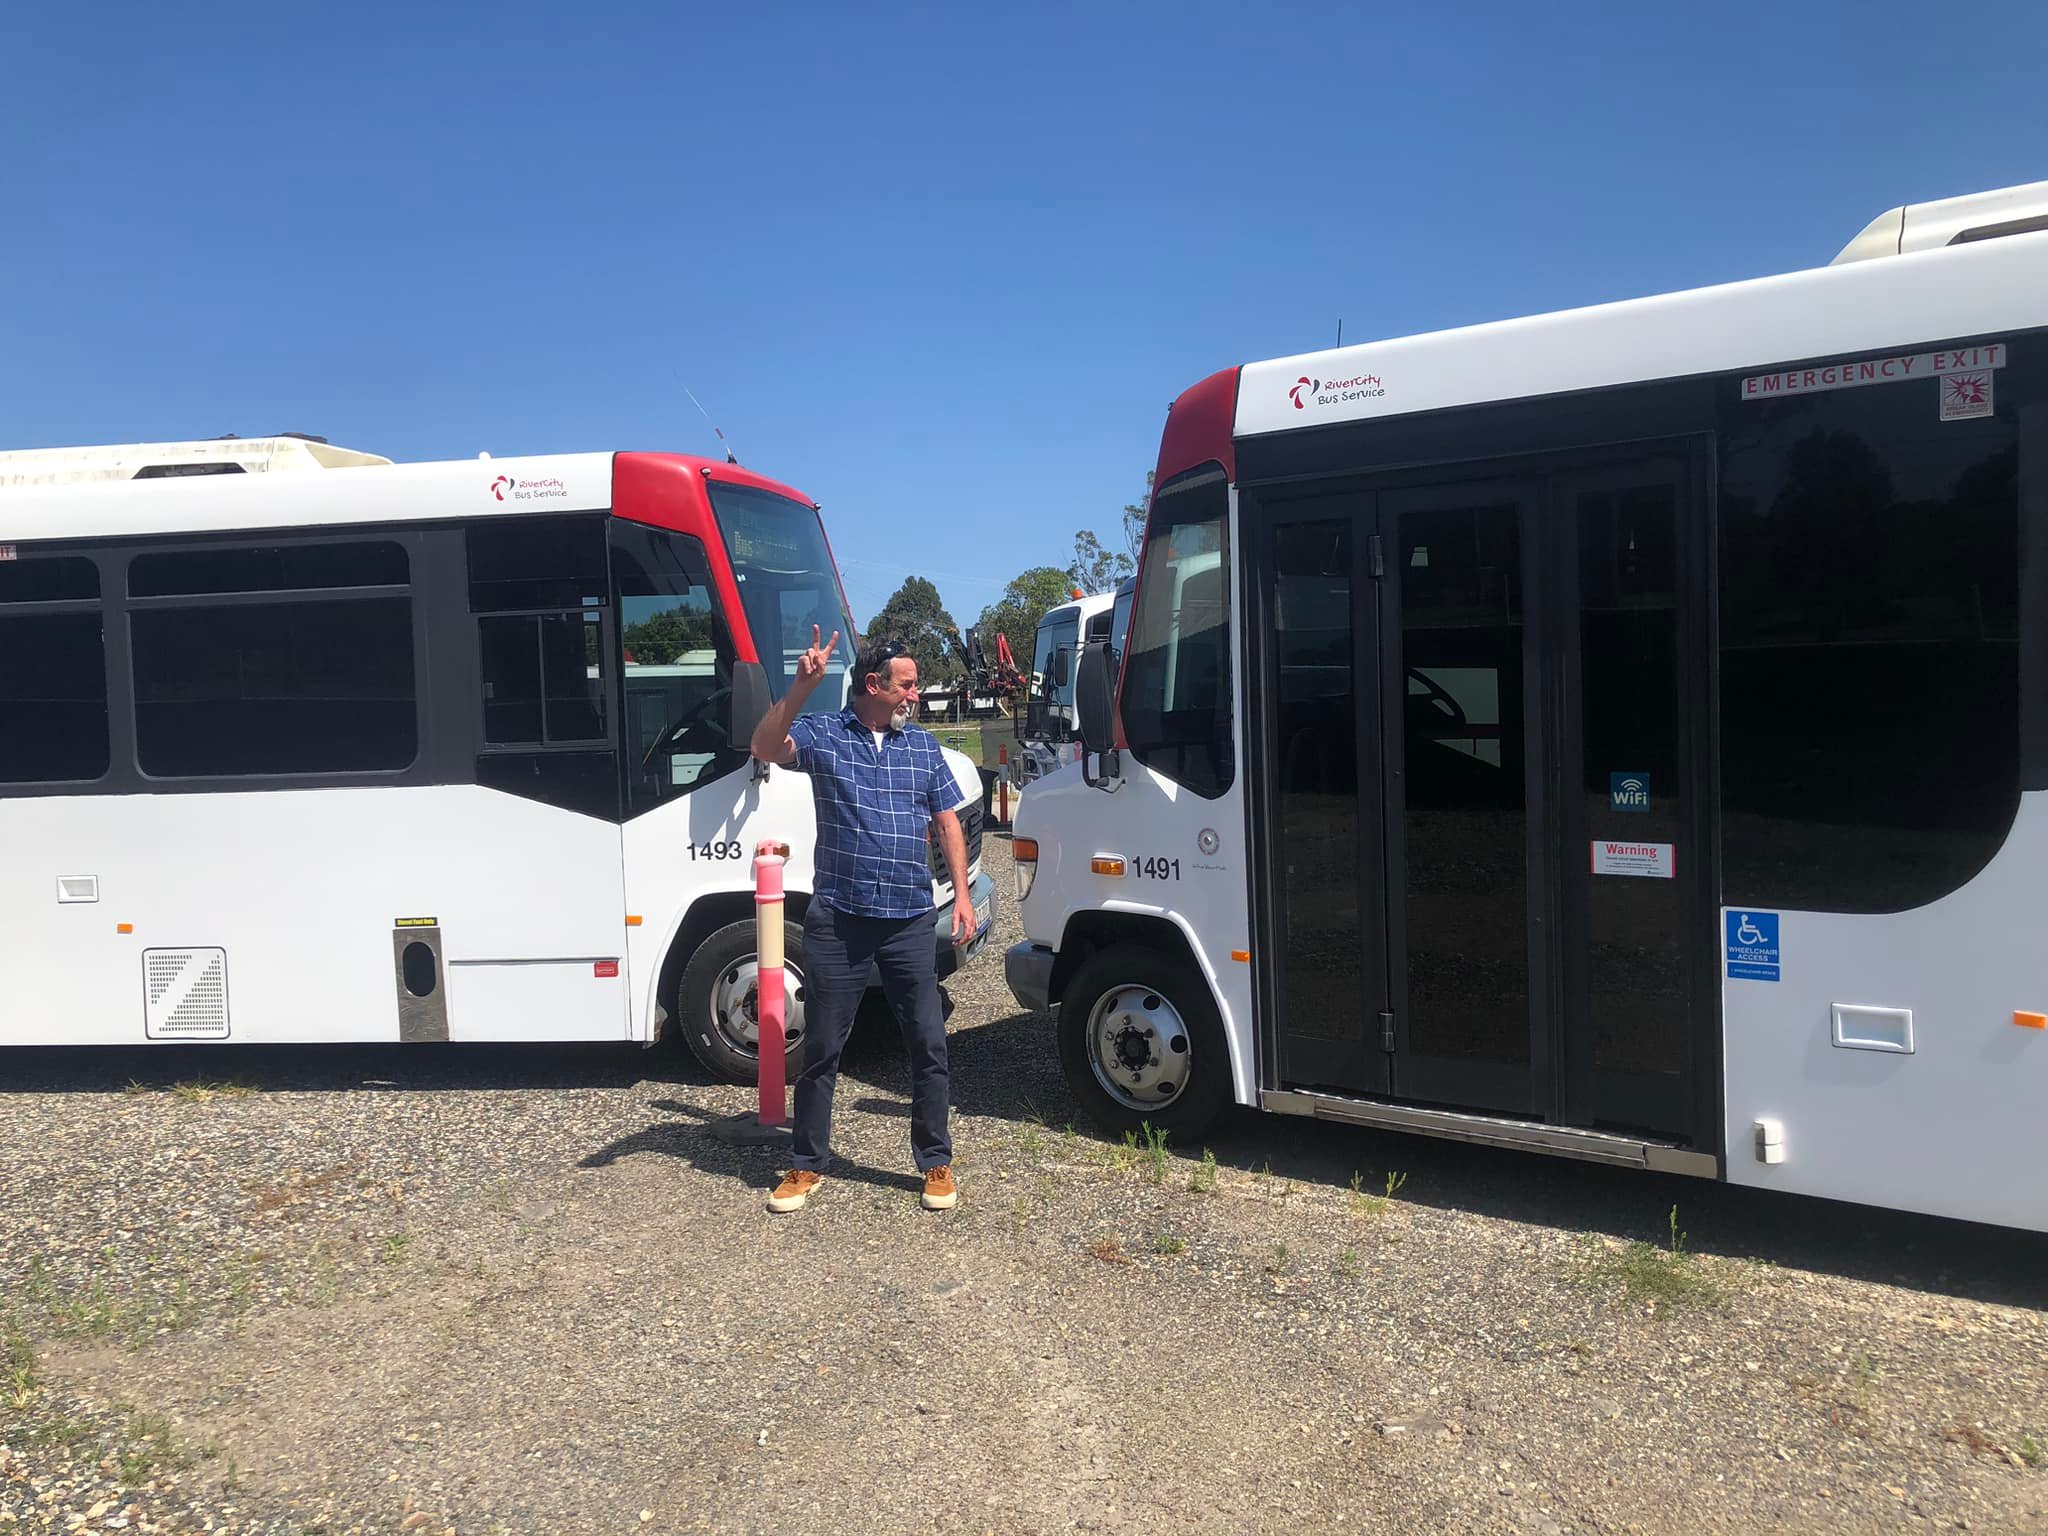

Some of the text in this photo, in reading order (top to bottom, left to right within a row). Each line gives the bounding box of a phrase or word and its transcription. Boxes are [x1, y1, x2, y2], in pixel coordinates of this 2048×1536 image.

[1746, 346, 1999, 394] EMERGENCY EXIT
[1341, 386, 1385, 401] Service
[1613, 791, 1647, 805] WiFi
[686, 841, 742, 861] 1493
[1605, 843, 1657, 858] Warning
[1132, 856, 1180, 880] 1491
[1728, 946, 1777, 955] WHEELCHAIR
